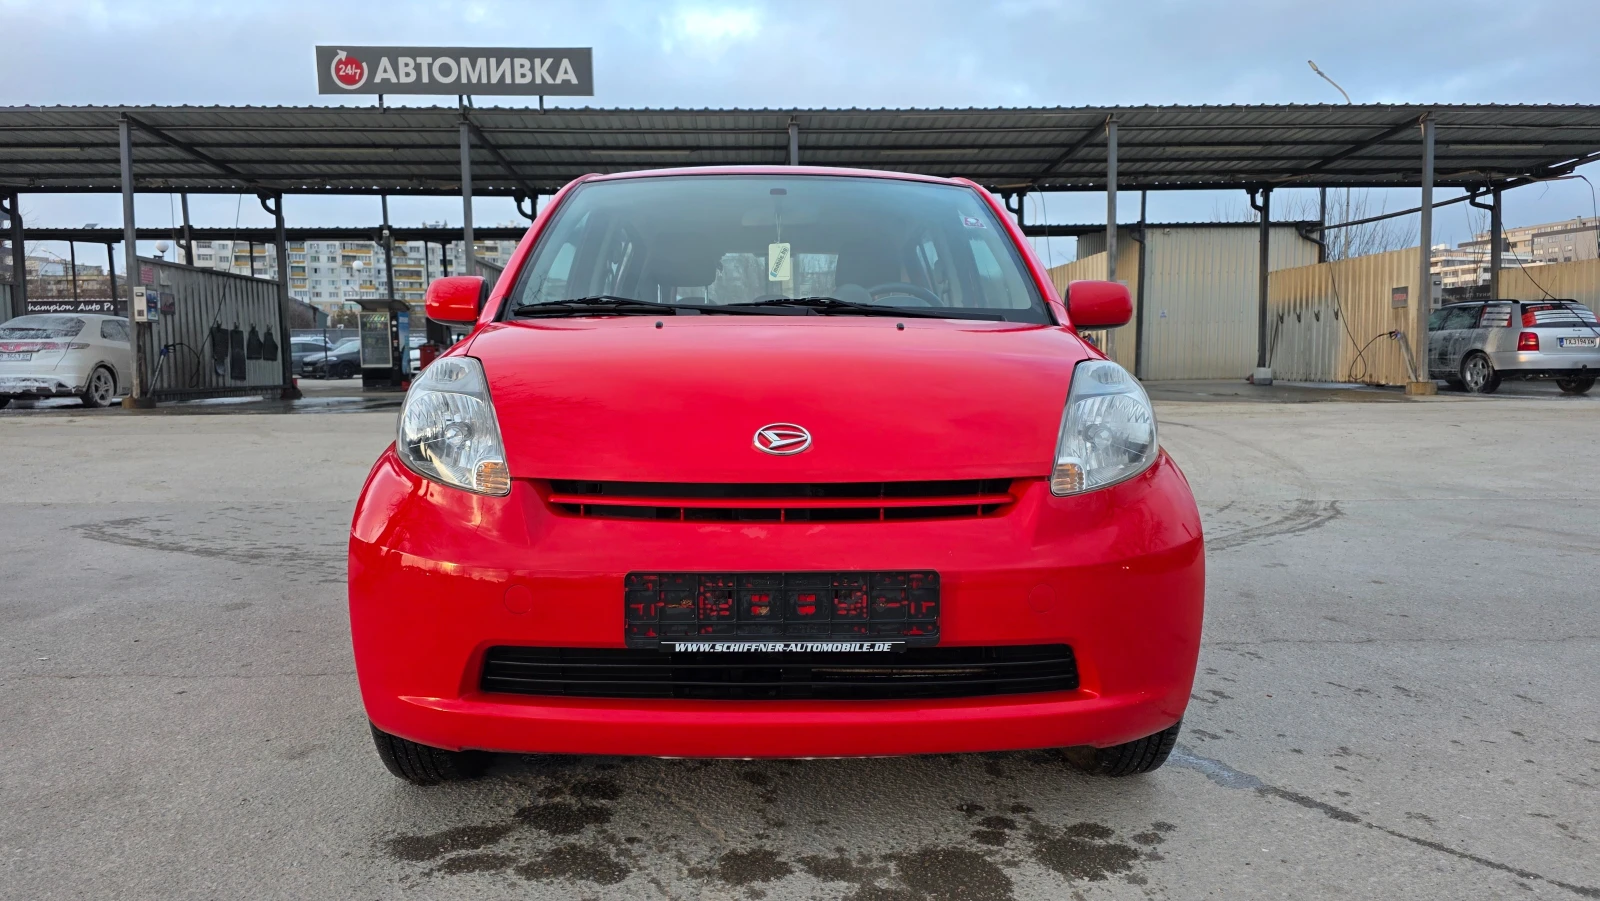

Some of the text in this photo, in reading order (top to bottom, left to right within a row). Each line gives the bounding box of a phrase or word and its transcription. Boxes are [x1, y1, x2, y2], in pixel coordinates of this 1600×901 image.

[338, 64, 361, 80] 24/7
[374, 56, 579, 85] АВТОМИВКА
[773, 247, 788, 273] mobile.bg
[28, 303, 75, 313] hampion
[77, 302, 101, 312] Auto
[674, 643, 892, 653] WWW.SCHIFFNER-AUTOMOBILE.DE
